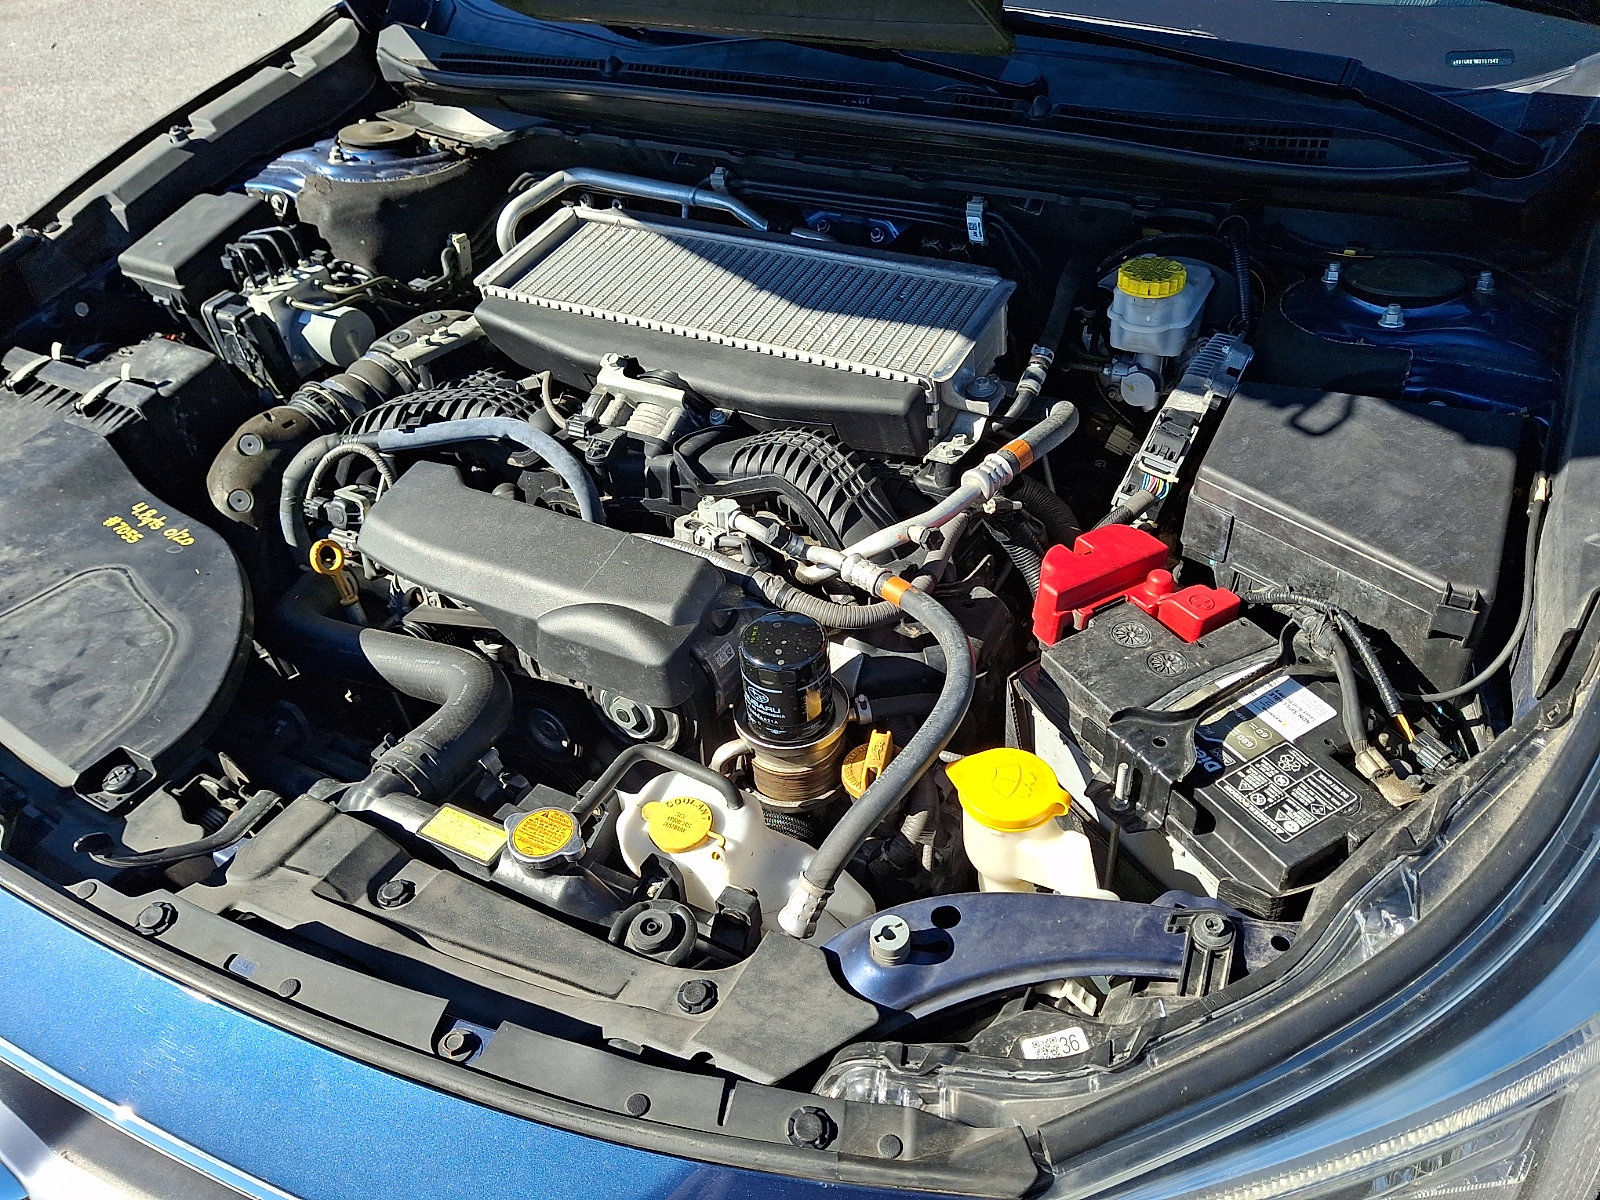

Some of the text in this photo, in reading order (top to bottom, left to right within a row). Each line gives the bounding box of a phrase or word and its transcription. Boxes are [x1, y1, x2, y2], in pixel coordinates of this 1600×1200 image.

[102, 516, 145, 544] #7055
[1237, 735, 1254, 748] 680
[1256, 728, 1269, 738] 60
[1329, 783, 1343, 793] NOT
[665, 798, 712, 822] COOLANT
[1222, 784, 1278, 830] DANGER/POISON
[1060, 1034, 1080, 1054] 36
